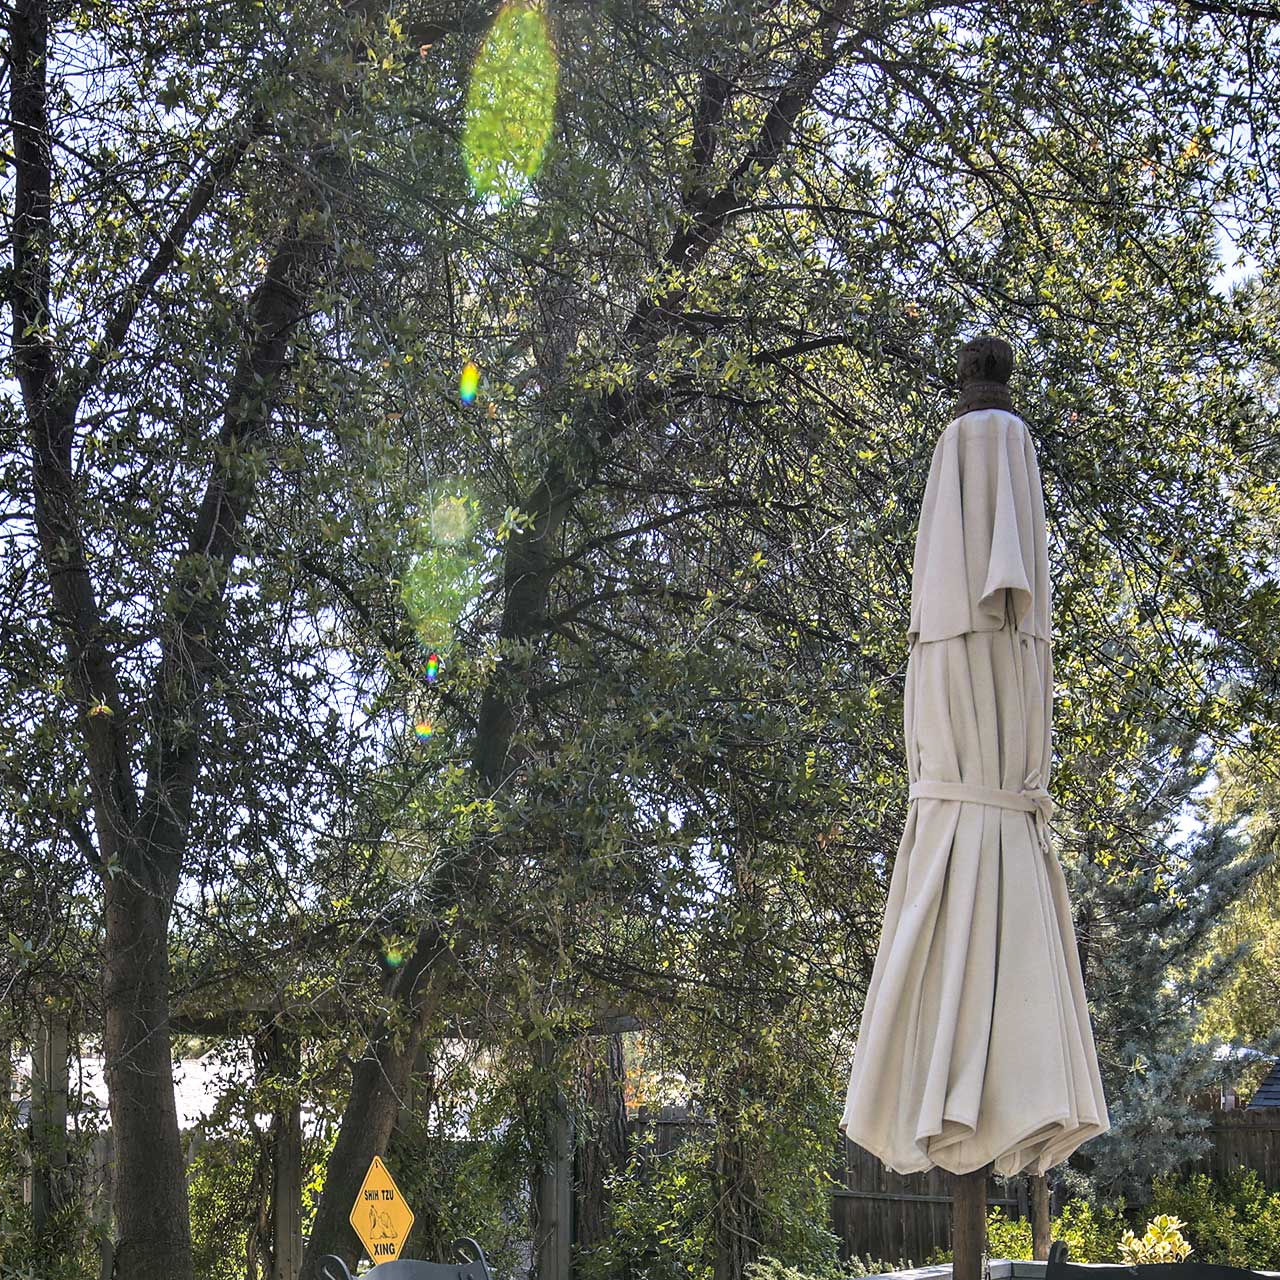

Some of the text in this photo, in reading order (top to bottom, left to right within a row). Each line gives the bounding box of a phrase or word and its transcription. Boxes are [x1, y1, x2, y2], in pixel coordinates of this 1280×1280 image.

[364, 1189, 394, 1201] SHIH TZU
[373, 1243, 395, 1256] XING
